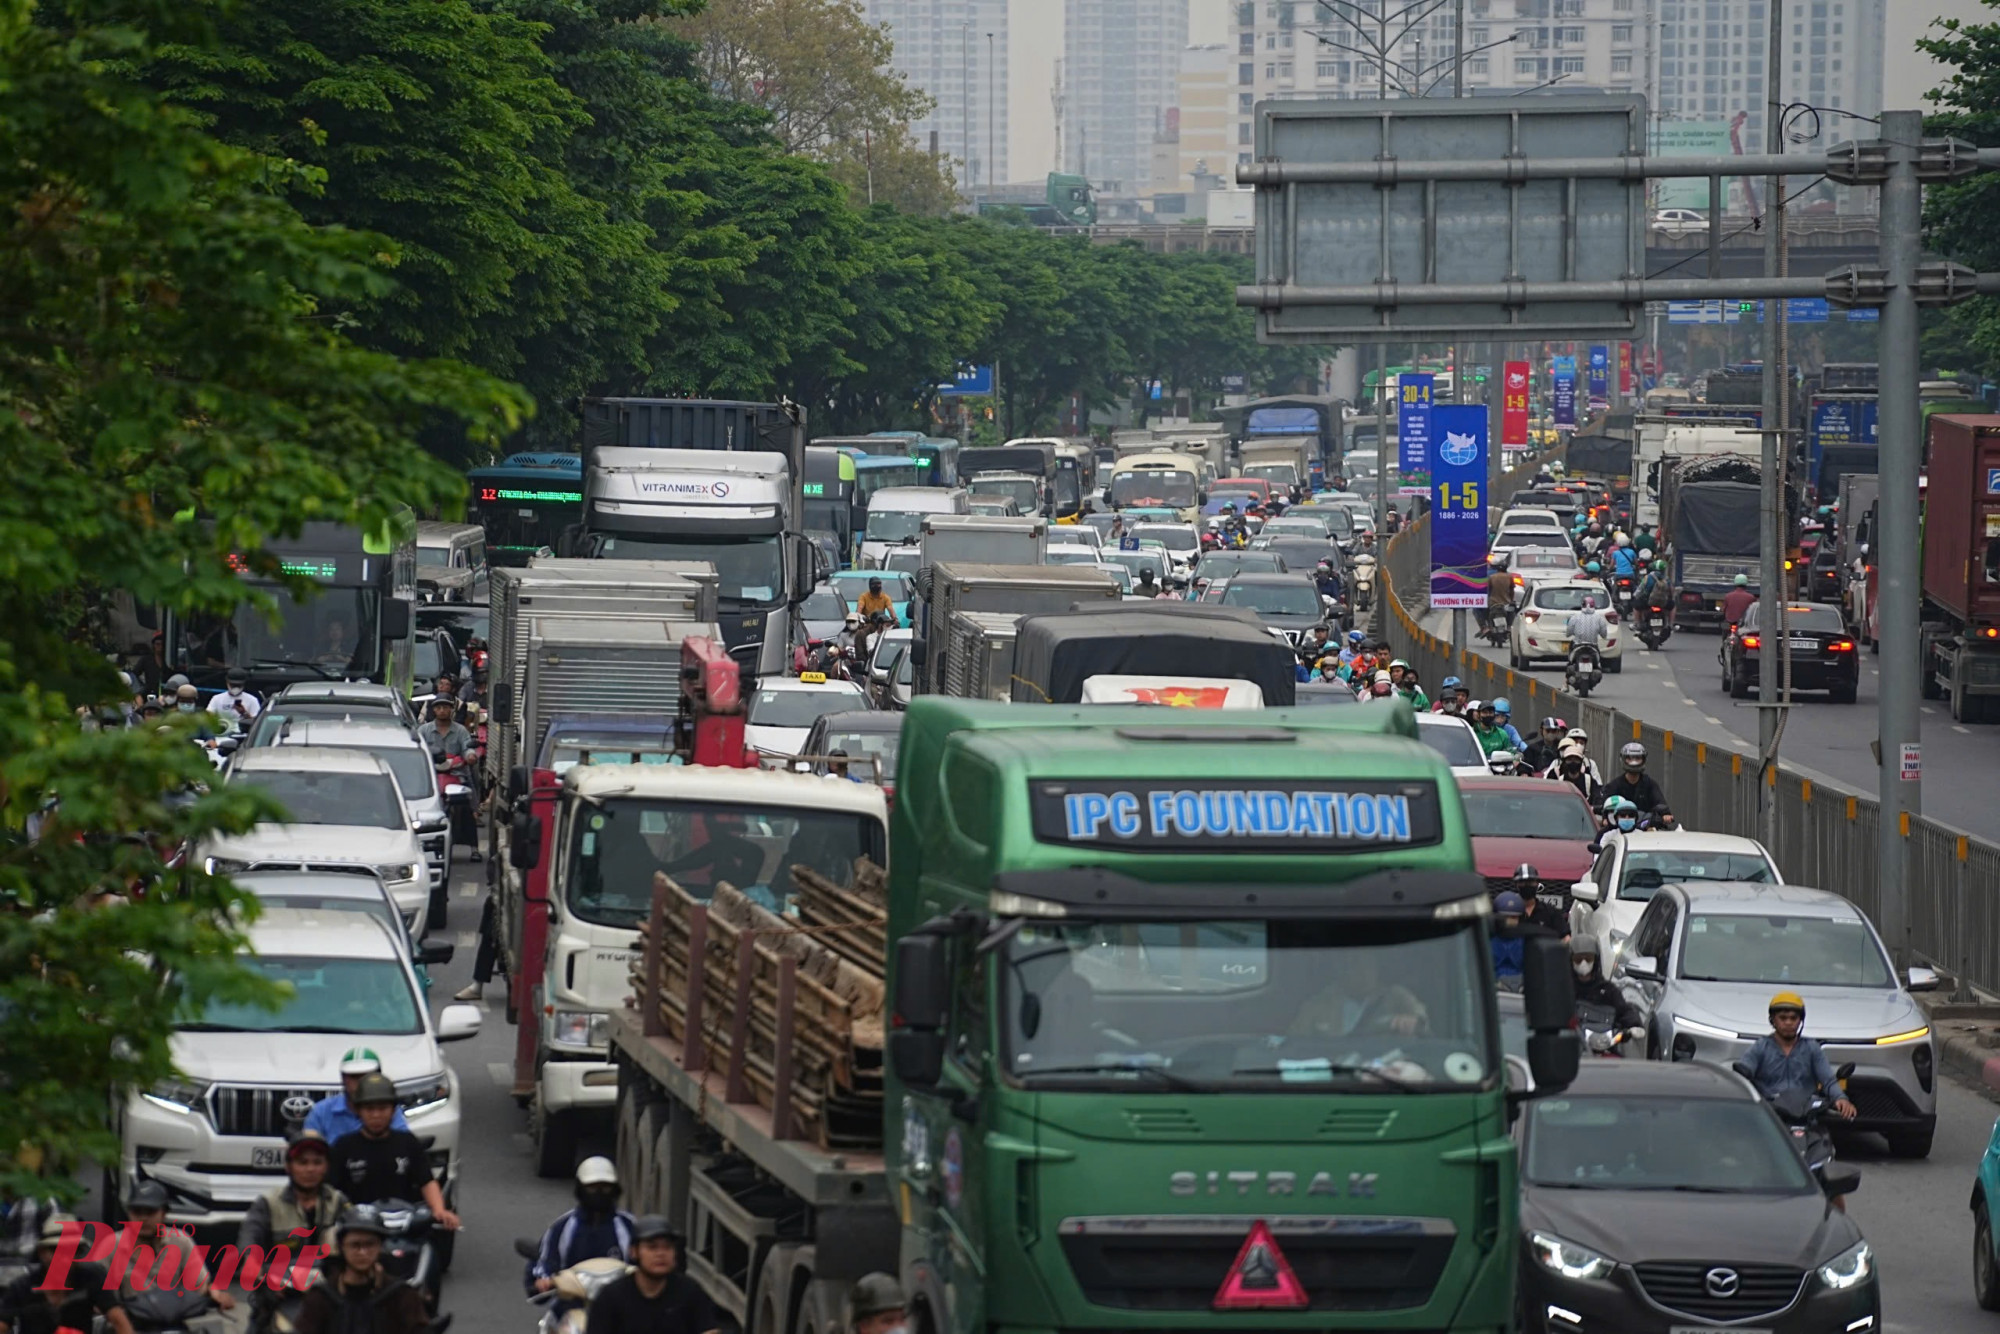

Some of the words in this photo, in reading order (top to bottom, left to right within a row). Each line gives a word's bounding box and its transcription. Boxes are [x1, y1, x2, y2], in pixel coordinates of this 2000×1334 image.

[1403, 385, 1429, 403] 30-4
[1507, 395, 1525, 408] 1-5
[481, 489, 496, 500] 12
[642, 483, 708, 493] VITRANIMEX
[1438, 482, 1479, 509] 1-5
[1433, 597, 1459, 606] PHƯỜNG
[1460, 597, 1474, 606] YÊN
[1475, 597, 1484, 606] SỞ
[1064, 791, 1141, 839] IPC
[1148, 790, 1412, 841] FOUNDATION
[1170, 1171, 1379, 1196] SITRAK
